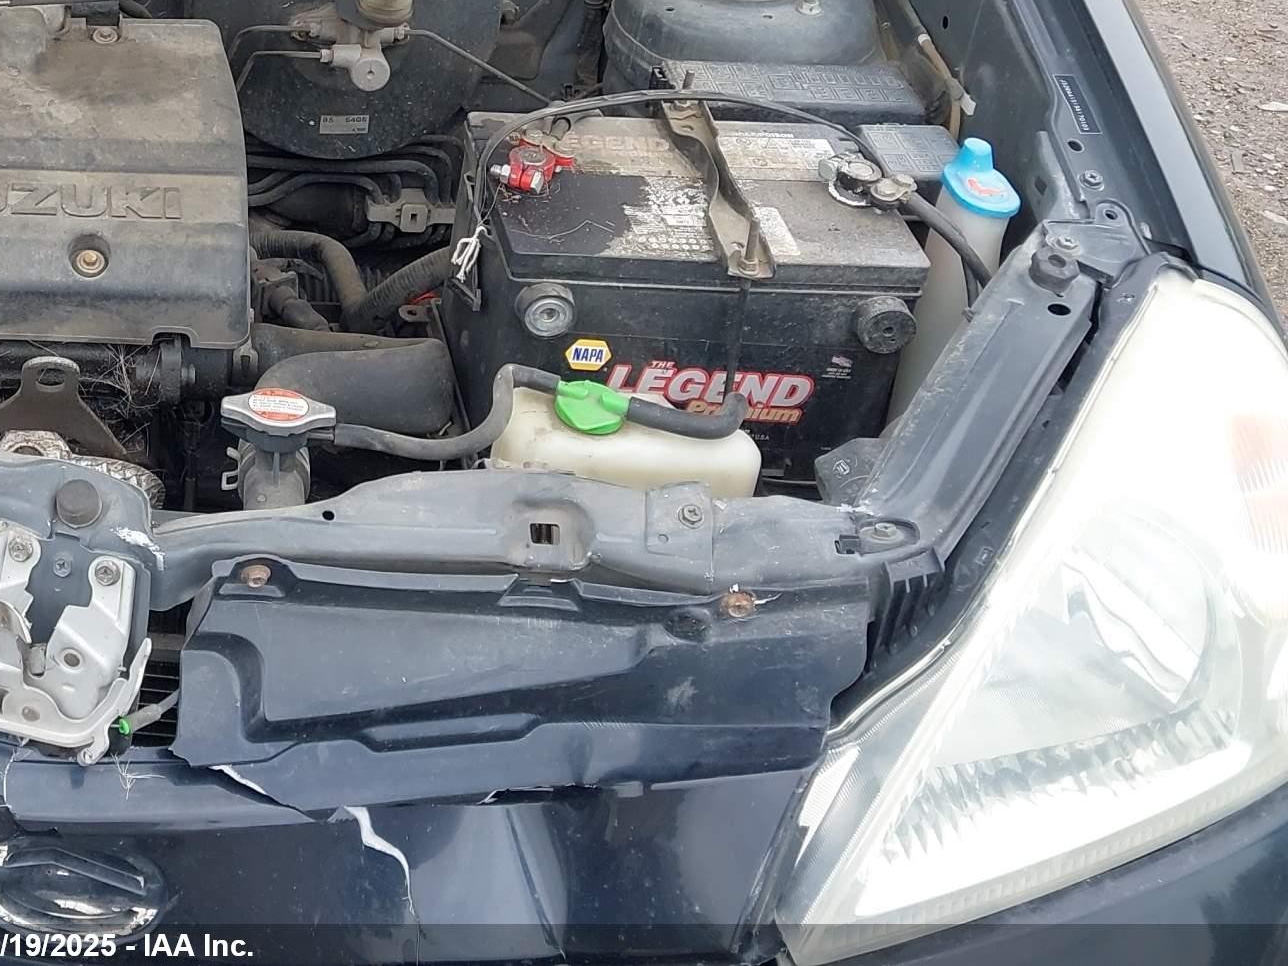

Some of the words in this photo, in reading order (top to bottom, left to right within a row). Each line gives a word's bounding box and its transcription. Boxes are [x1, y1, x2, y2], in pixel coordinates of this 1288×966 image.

[572, 346, 604, 363] NAPA
[650, 360, 676, 369] THE
[607, 365, 815, 407] LEGEND
